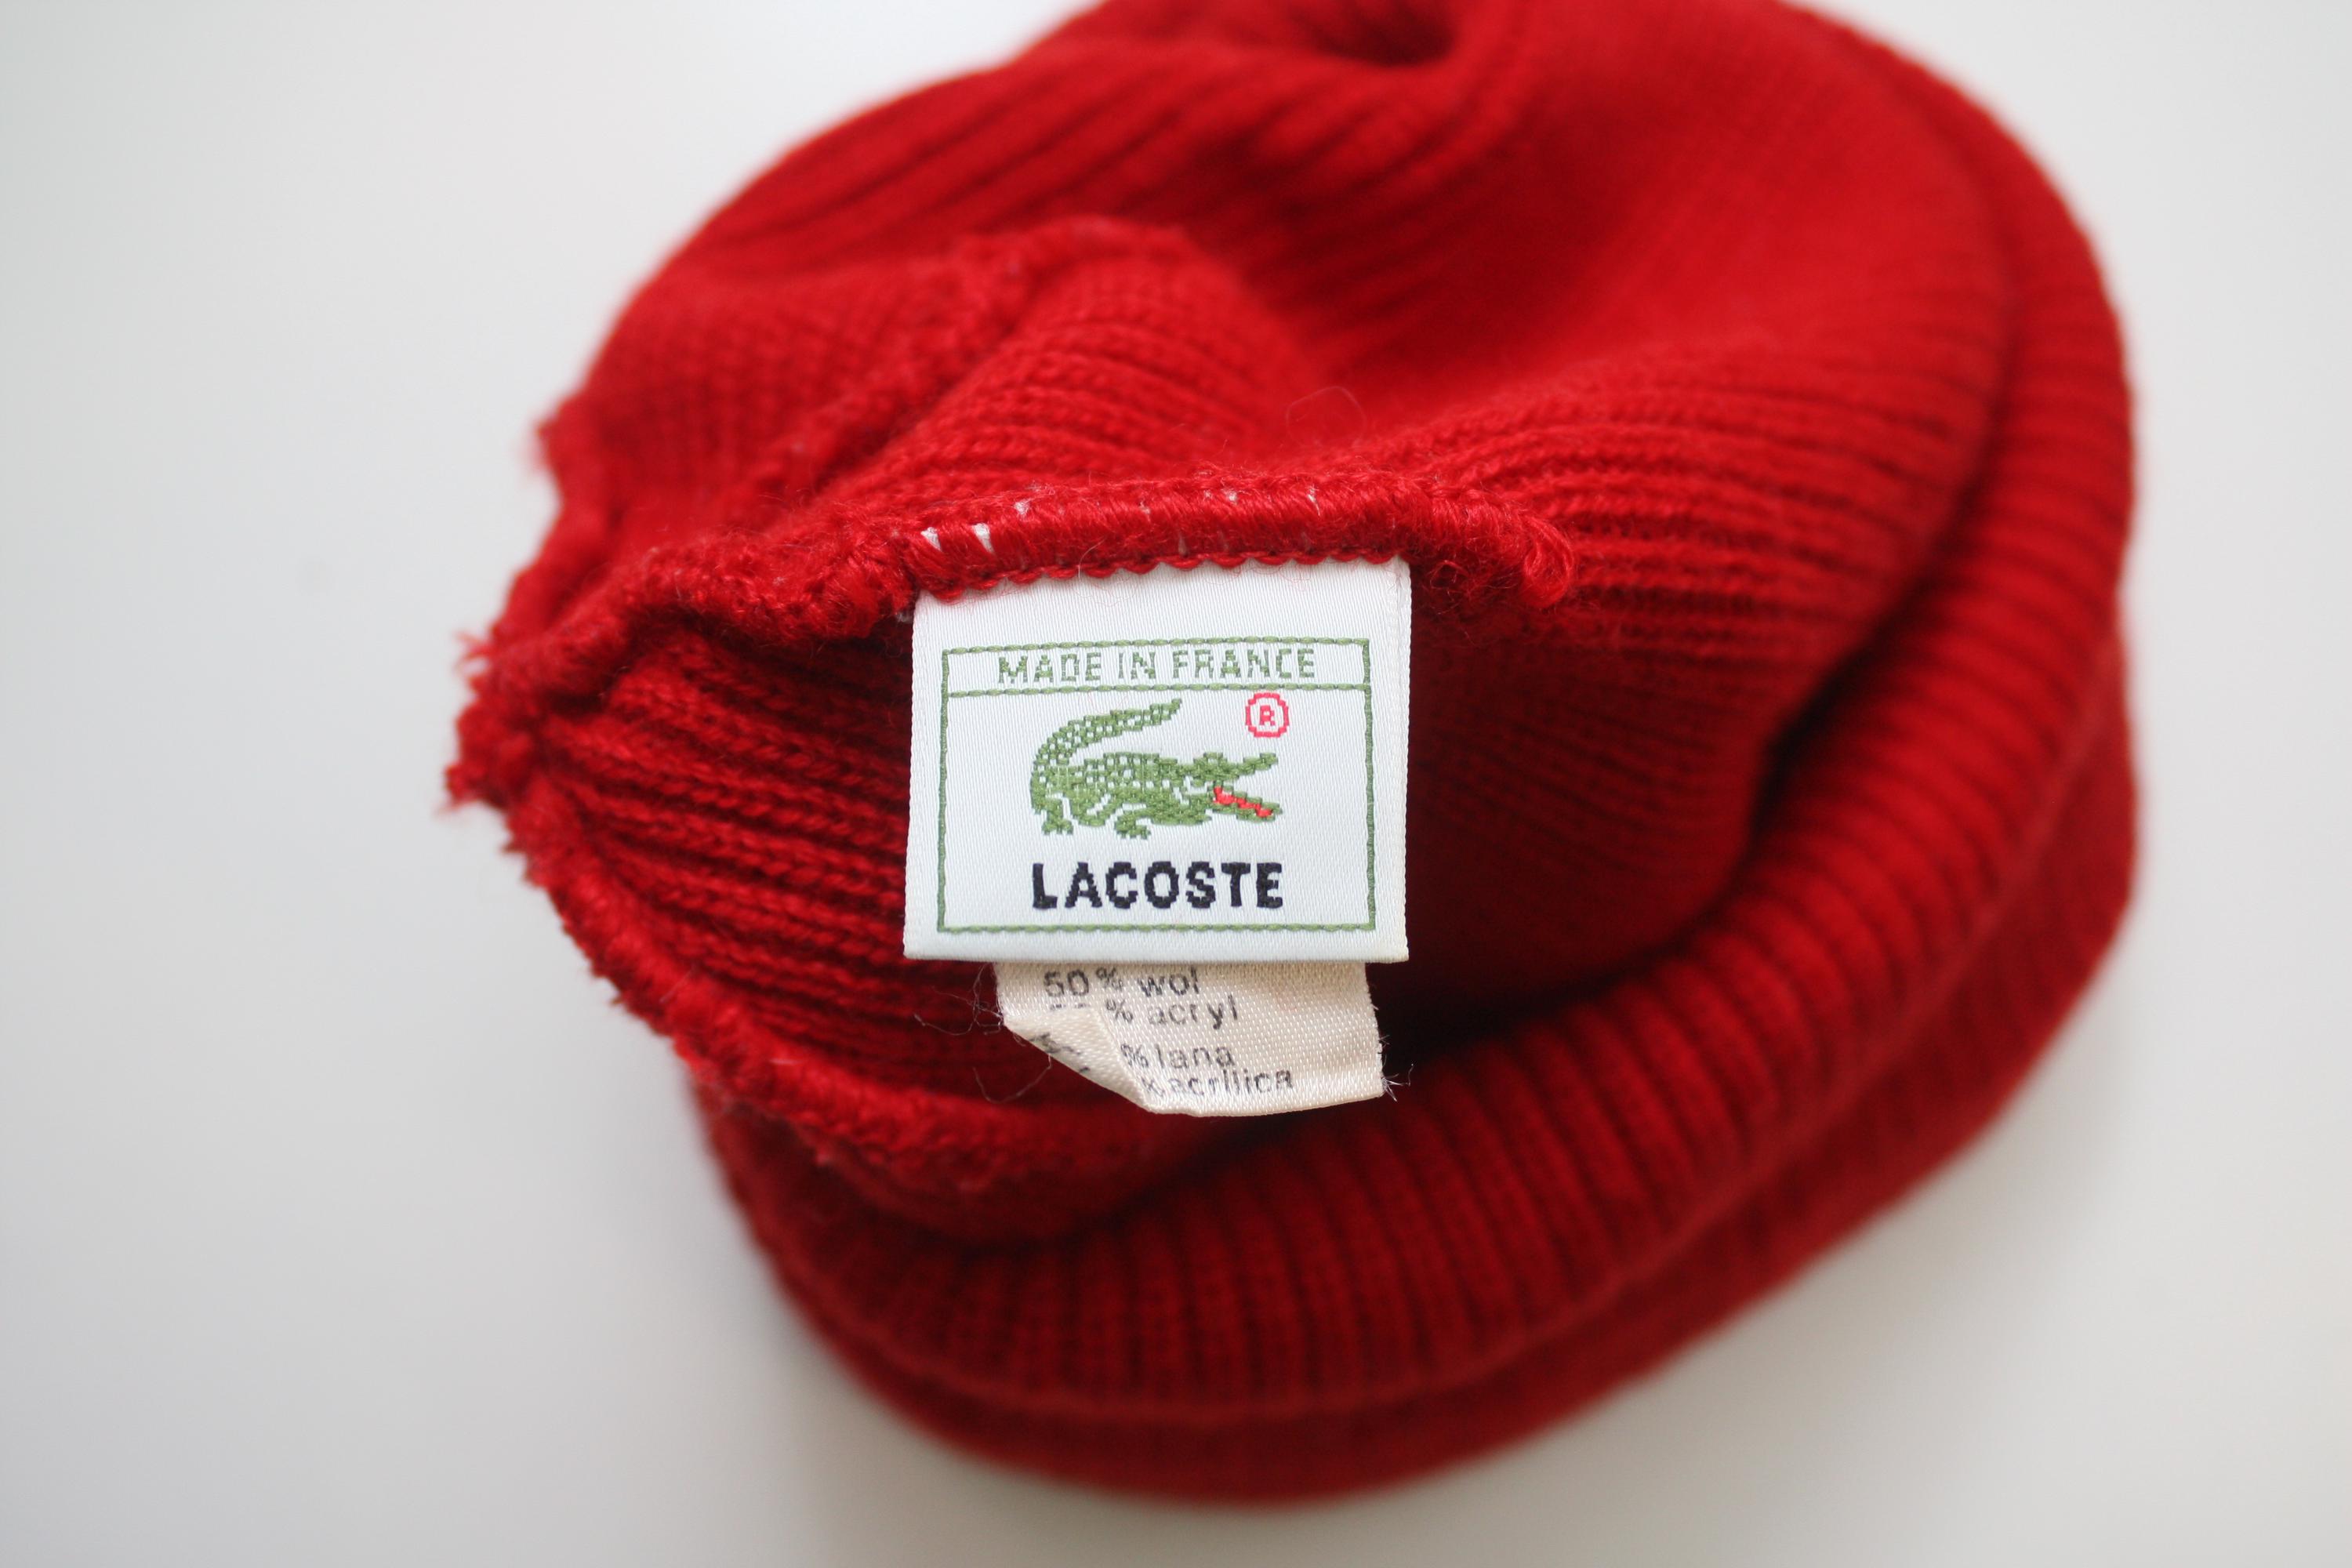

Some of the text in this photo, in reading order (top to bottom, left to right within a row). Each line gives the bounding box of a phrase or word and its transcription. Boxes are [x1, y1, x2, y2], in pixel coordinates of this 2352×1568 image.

[998, 648, 1315, 684] MADE IN FRANCE
[1032, 862, 1283, 909] LACOSTE
[1044, 969, 1090, 997] 50
[1138, 966, 1200, 997] wol
[1148, 994, 1238, 1030] acryl
[1155, 1044, 1236, 1069] lana
